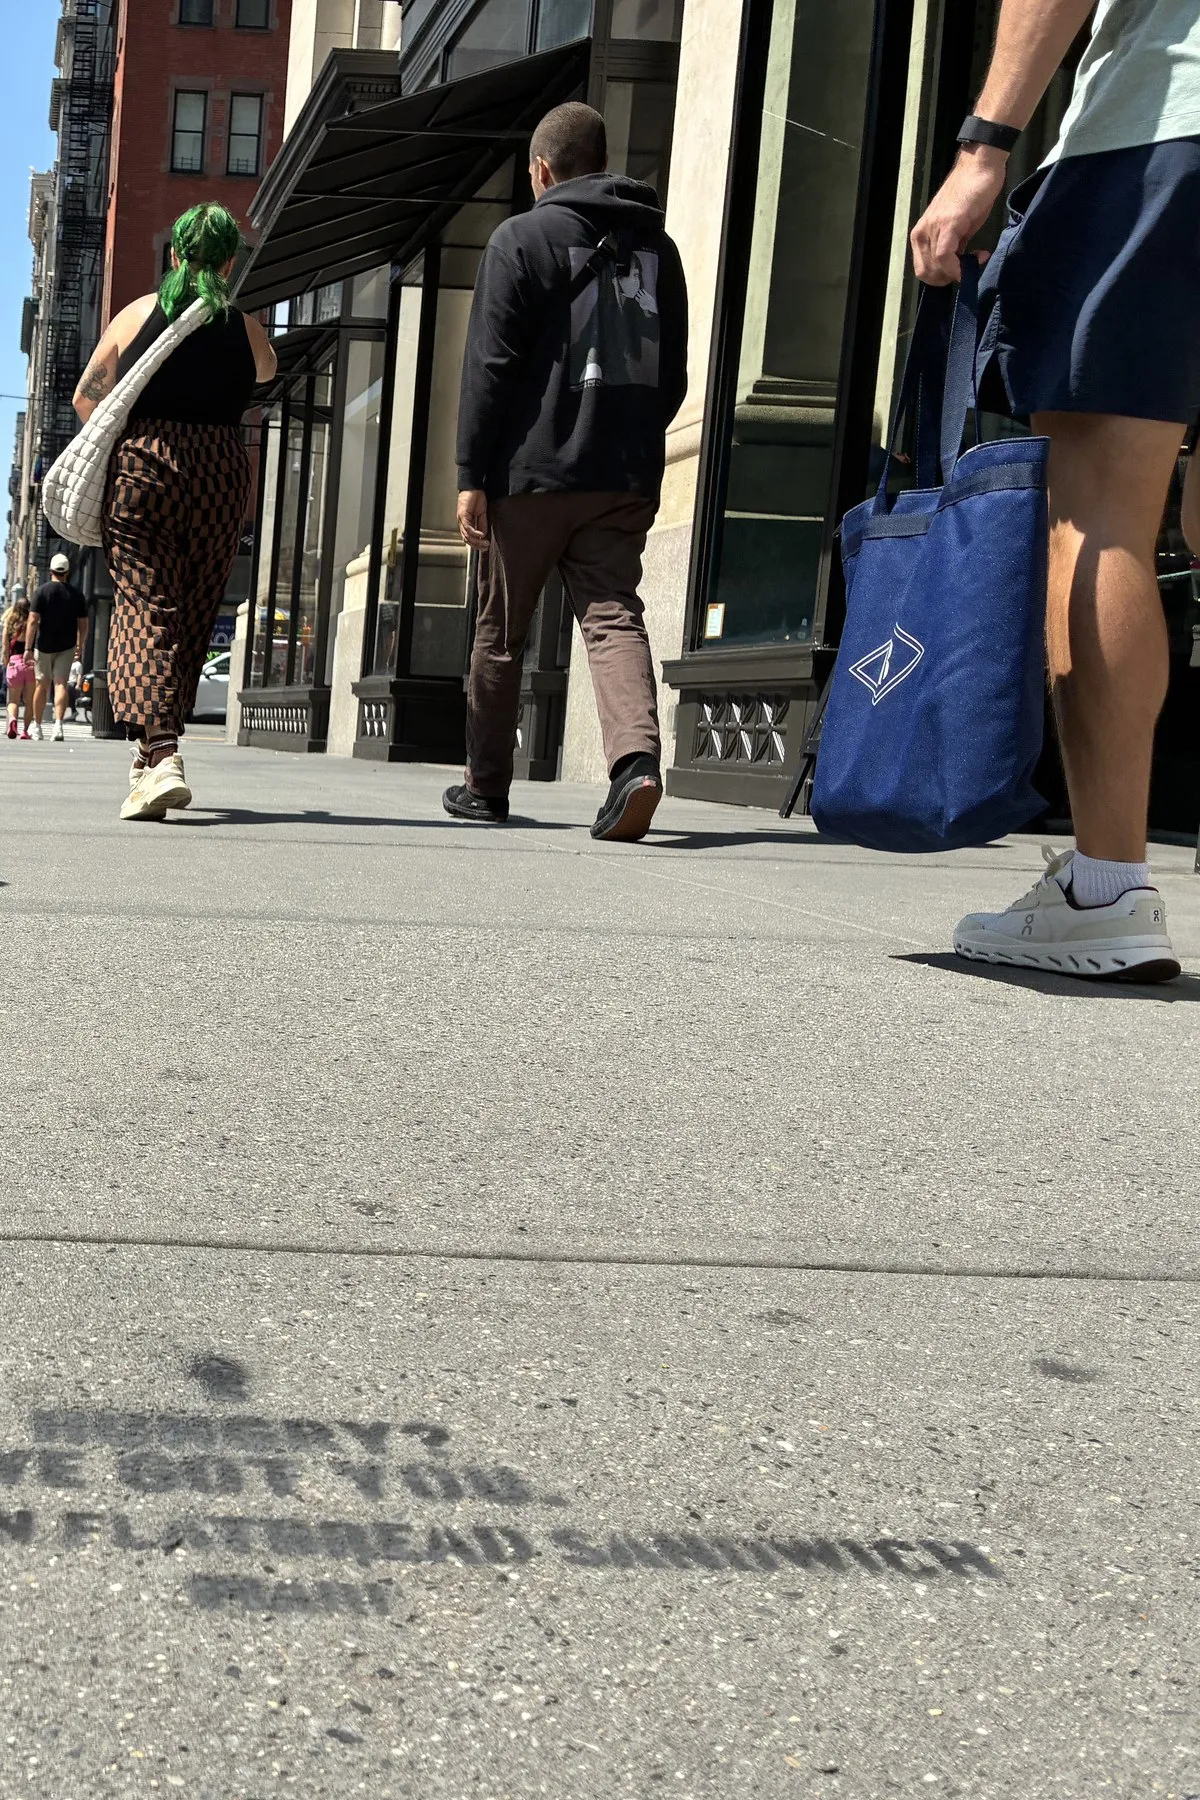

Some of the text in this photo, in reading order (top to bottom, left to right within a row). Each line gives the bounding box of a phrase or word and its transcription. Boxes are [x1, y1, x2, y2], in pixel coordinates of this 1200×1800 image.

[116, 1450, 301, 1498] GOT
[62, 1509, 535, 1567] FLATBREAD
[549, 1527, 1004, 1582] SANDWICH
